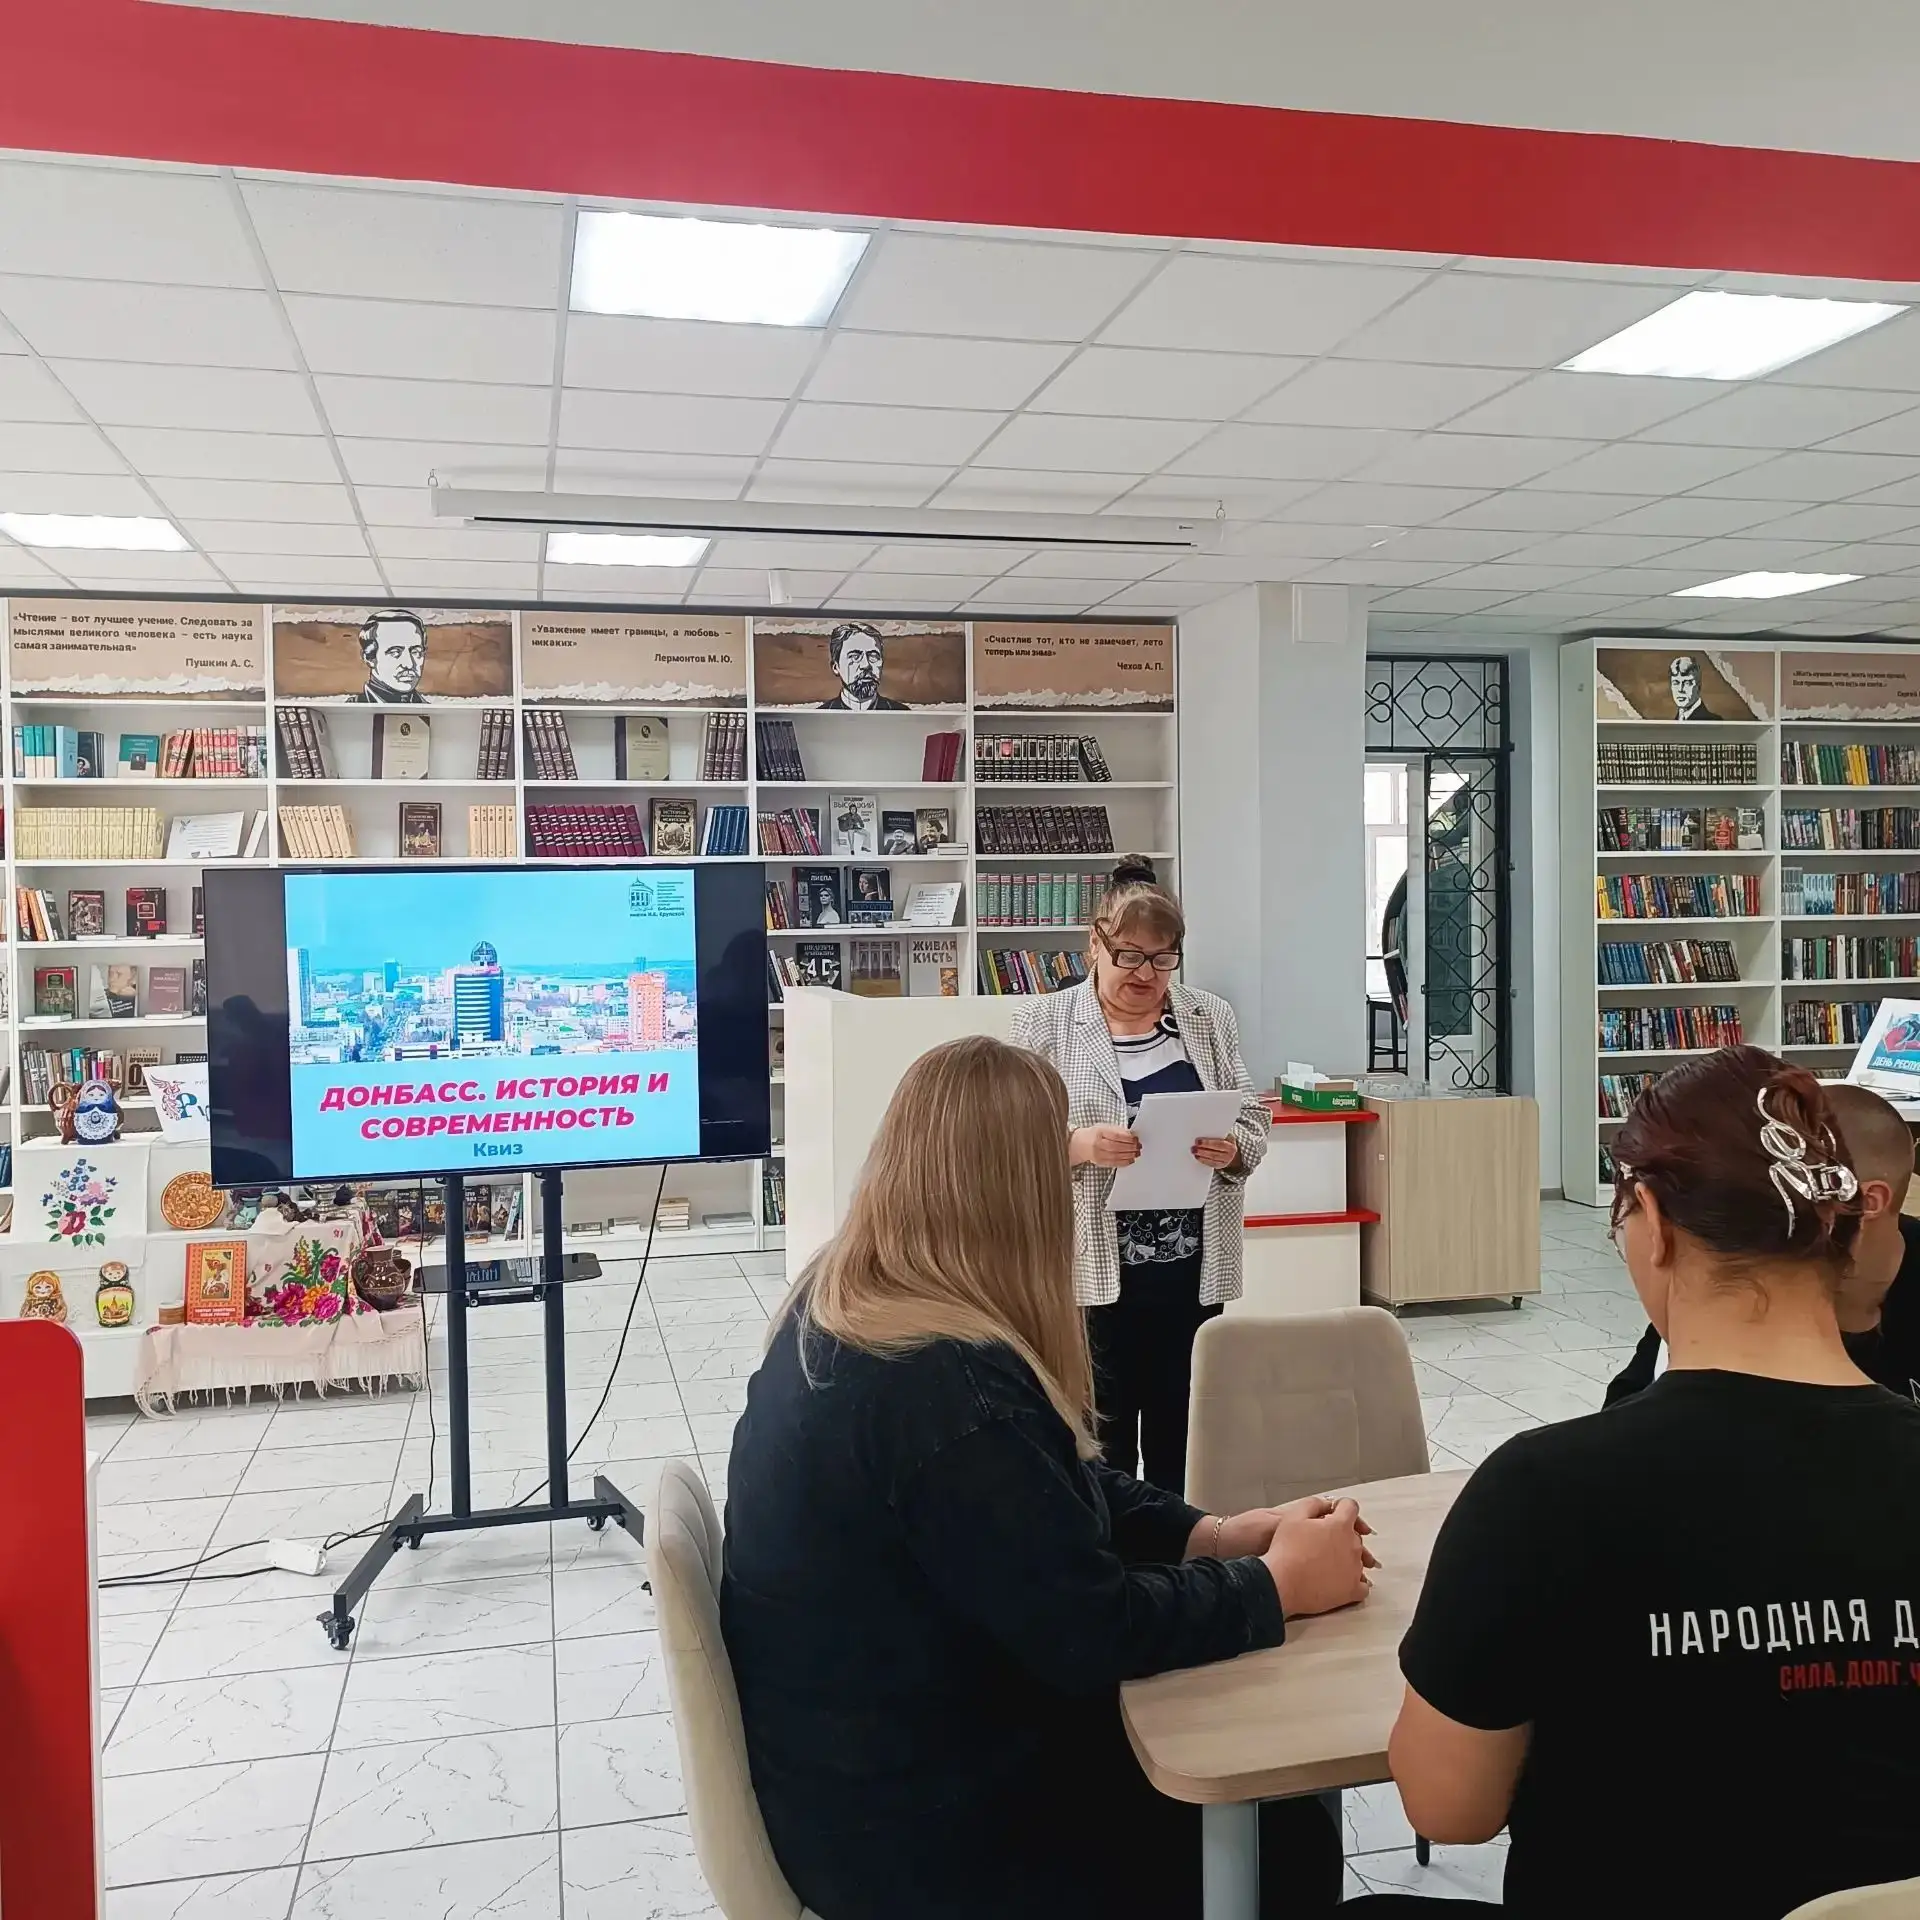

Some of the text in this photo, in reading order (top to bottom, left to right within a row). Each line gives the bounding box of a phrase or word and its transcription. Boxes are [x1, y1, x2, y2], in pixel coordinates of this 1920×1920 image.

[13, 612, 57, 622] «Чтение
[71, 615, 90, 623] вот
[94, 616, 134, 627] лучшее
[138, 617, 177, 627] учение.
[180, 616, 237, 627] Следовать
[241, 619, 253, 627] за
[13, 628, 65, 636] мыслями
[69, 630, 120, 638] великого
[125, 631, 176, 639] человека
[193, 632, 217, 640] есть
[222, 633, 253, 643] наука
[532, 625, 586, 635] «Уважение
[591, 627, 620, 635] имеет
[624, 628, 668, 638] границы,
[683, 629, 720, 637] любовь
[14, 641, 137, 652] самая занимательная»
[532, 639, 577, 647] никаких»
[984, 635, 1032, 644] «Счастлив
[1036, 638, 1055, 646] тот,
[654, 653, 706, 664] Лермонтов
[984, 648, 1015, 658] теперь
[185, 658, 228, 670] Пушкин
[1117, 662, 1143, 671] Чехов
[913, 952, 953, 964] КИСТЬ
[319, 1072, 670, 1112] ДОНБАСС. ИСТОРИЯ И
[360, 1105, 636, 1140] СОВРЕМЕННОСТЬ
[473, 1141, 524, 1157] Квиз
[1649, 1599, 1920, 1656] НАРОДНАЯ Д
